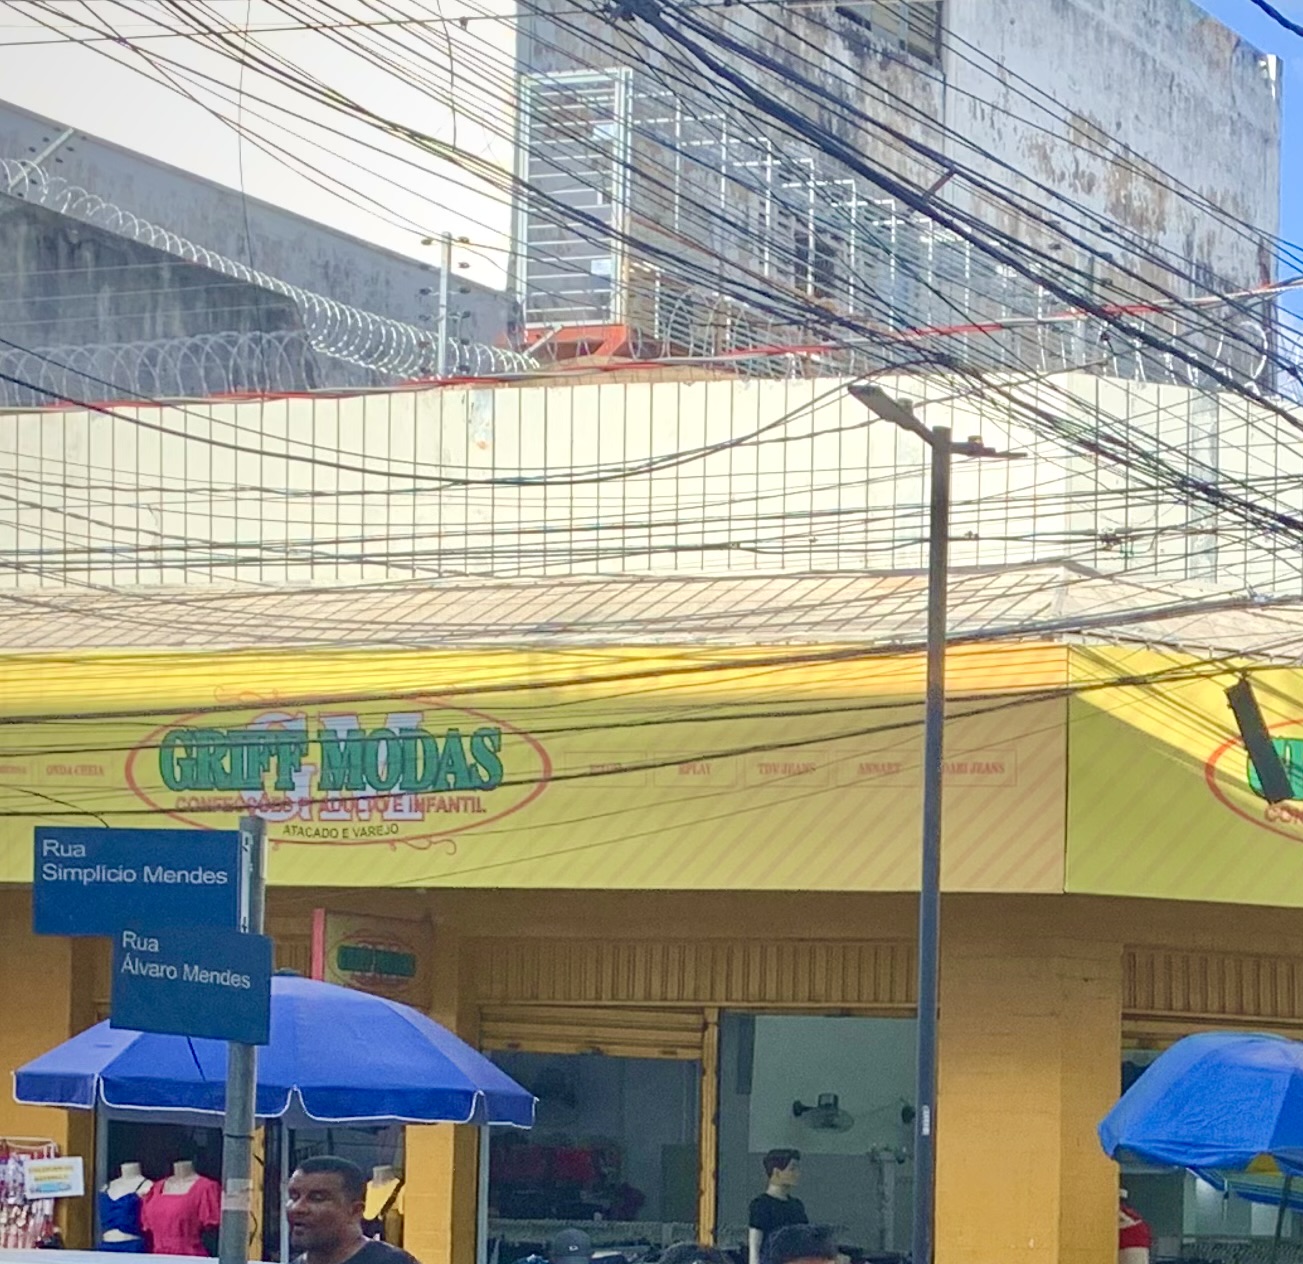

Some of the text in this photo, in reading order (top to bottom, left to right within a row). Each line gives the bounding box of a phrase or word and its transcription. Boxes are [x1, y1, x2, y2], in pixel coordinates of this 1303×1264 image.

[159, 727, 503, 792] GRIFF MODAS
[319, 796, 384, 813] ADULTO
[393, 796, 404, 813] E
[283, 823, 399, 838] ATACADO E VAREJO
[42, 839, 86, 857] Rua
[42, 863, 228, 886] Simplício Mendes
[122, 930, 159, 952] Rua
[121, 953, 250, 989] Álvaro Mendes
